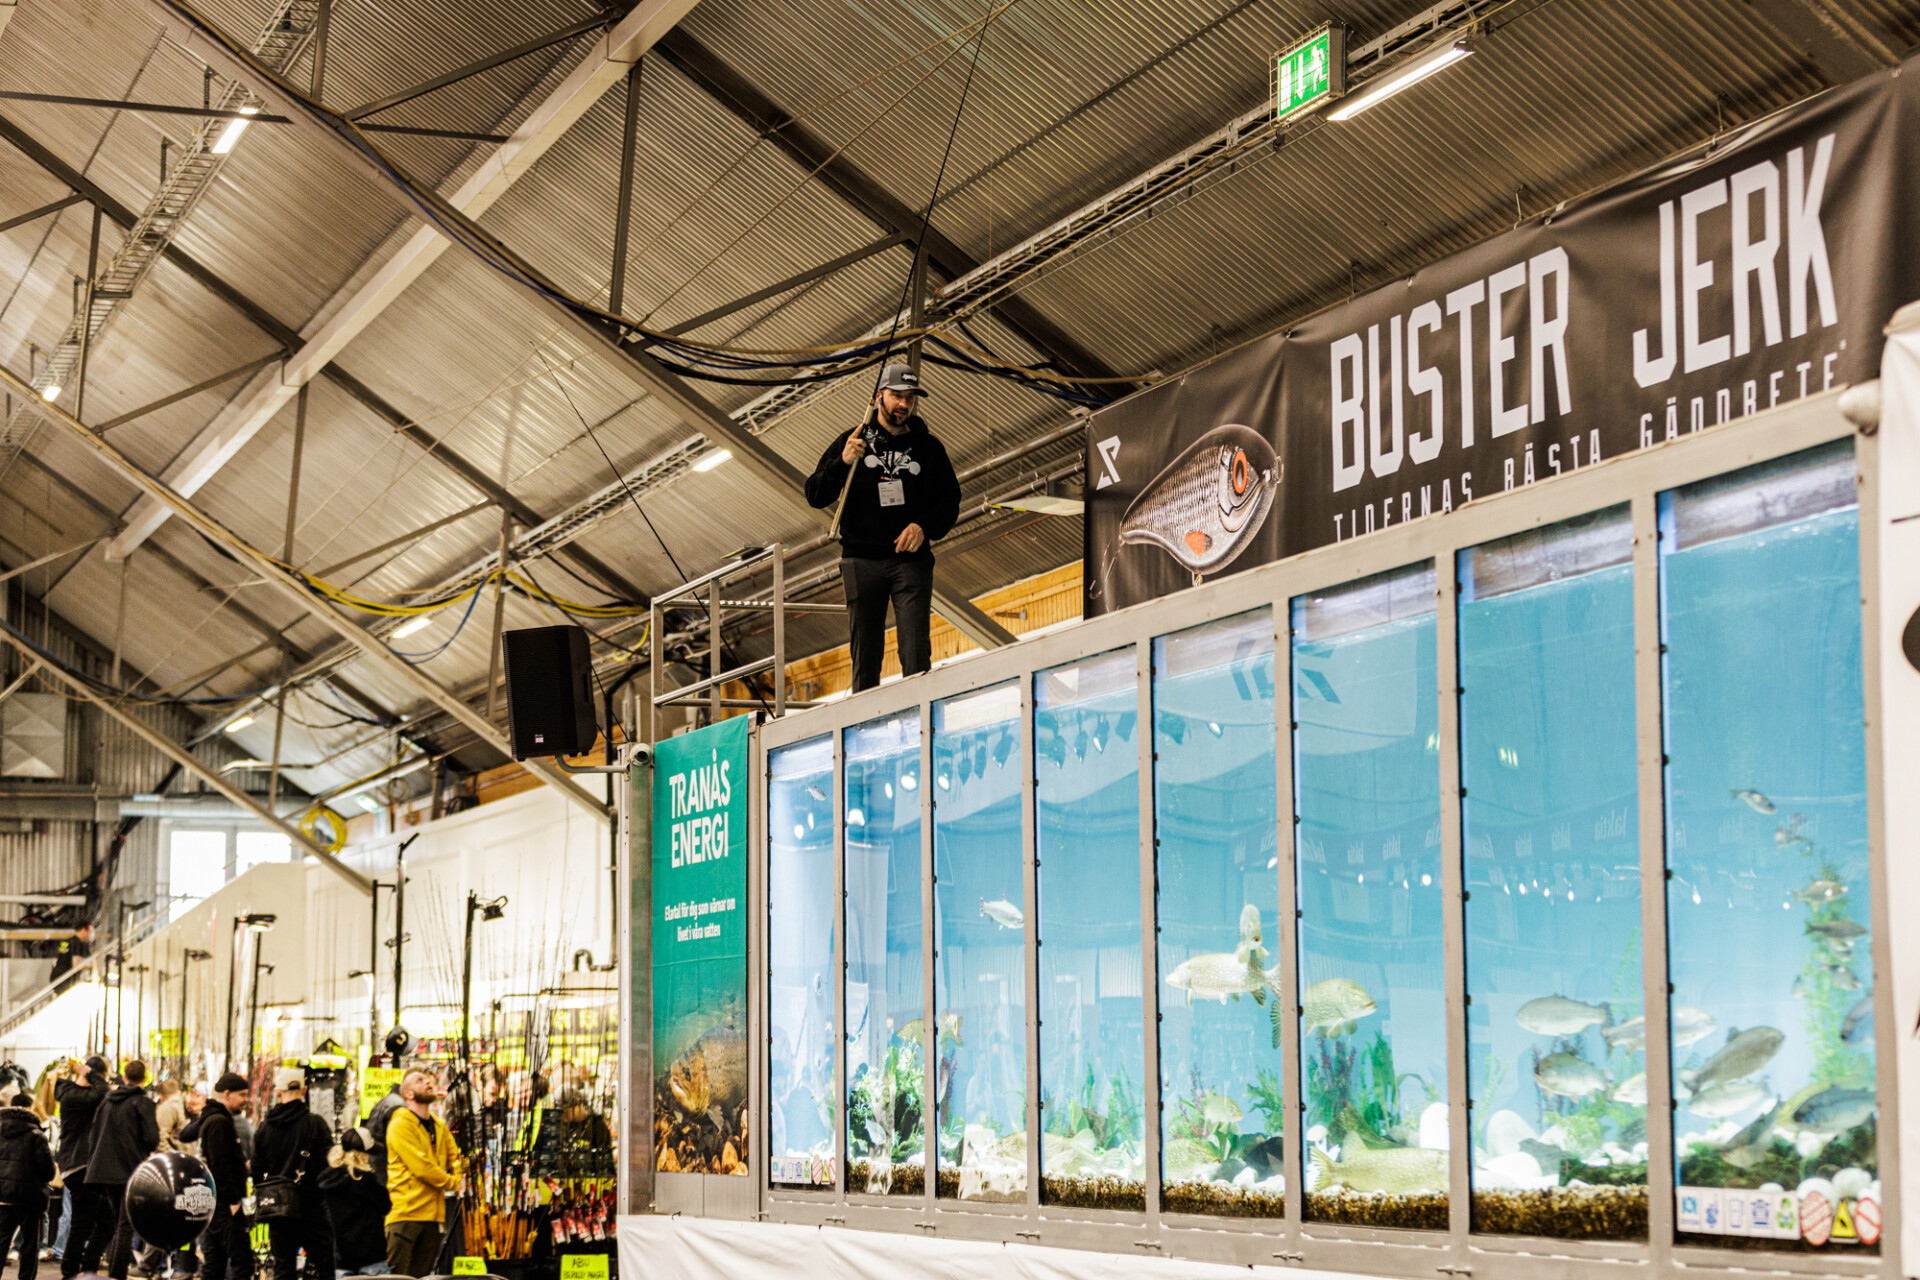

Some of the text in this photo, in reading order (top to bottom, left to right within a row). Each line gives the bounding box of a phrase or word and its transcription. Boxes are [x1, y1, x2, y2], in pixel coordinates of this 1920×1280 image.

[1330, 133, 1838, 493] BUSTER JERK
[1504, 428, 1601, 492] BÄSTA
[669, 748, 731, 819] TRANÅS
[671, 811, 729, 869] ENERGI
